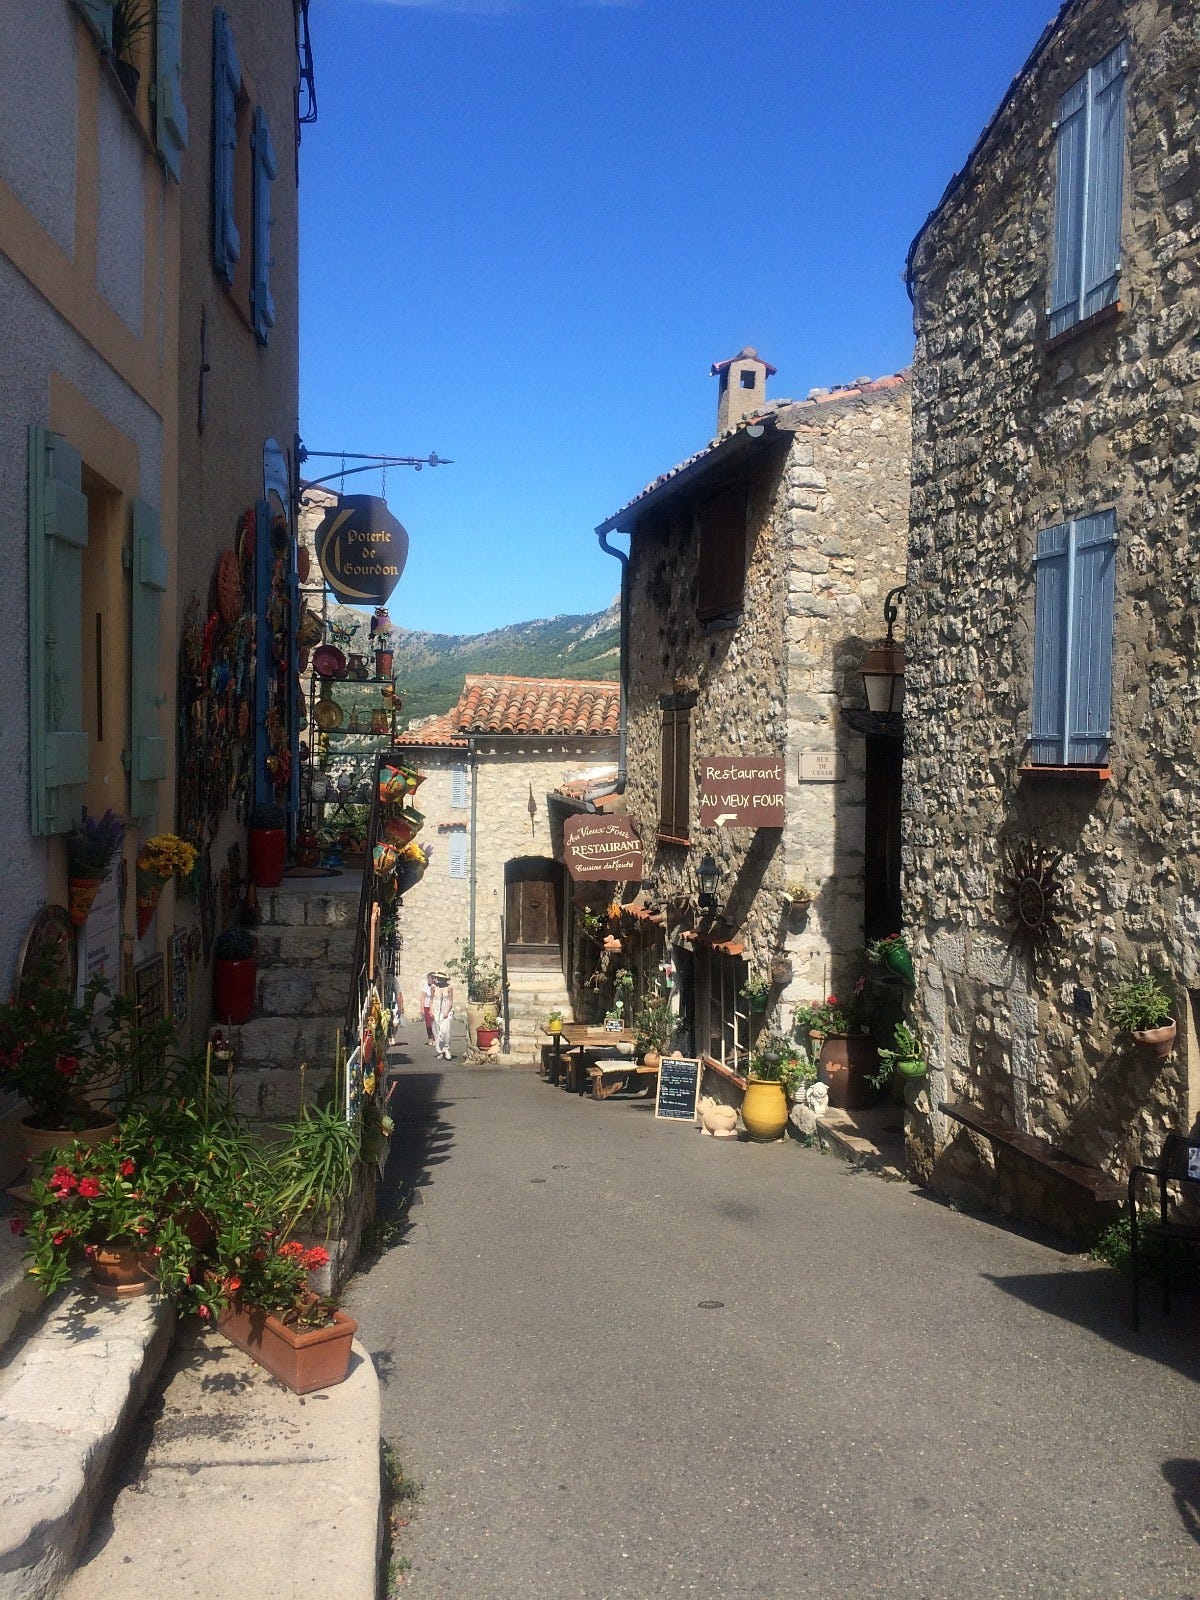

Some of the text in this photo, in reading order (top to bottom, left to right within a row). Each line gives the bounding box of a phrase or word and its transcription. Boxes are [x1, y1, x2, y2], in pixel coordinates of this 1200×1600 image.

[347, 530, 392, 545] Poterie
[362, 548, 376, 559] de
[343, 563, 399, 576] Gourdon
[706, 764, 782, 780] Restaurant
[702, 793, 784, 808] AU VIEUX FOUR
[566, 824, 631, 846] Au Vieux Four
[571, 839, 641, 856] RESTAURANT
[574, 863, 602, 873] Cuisine
